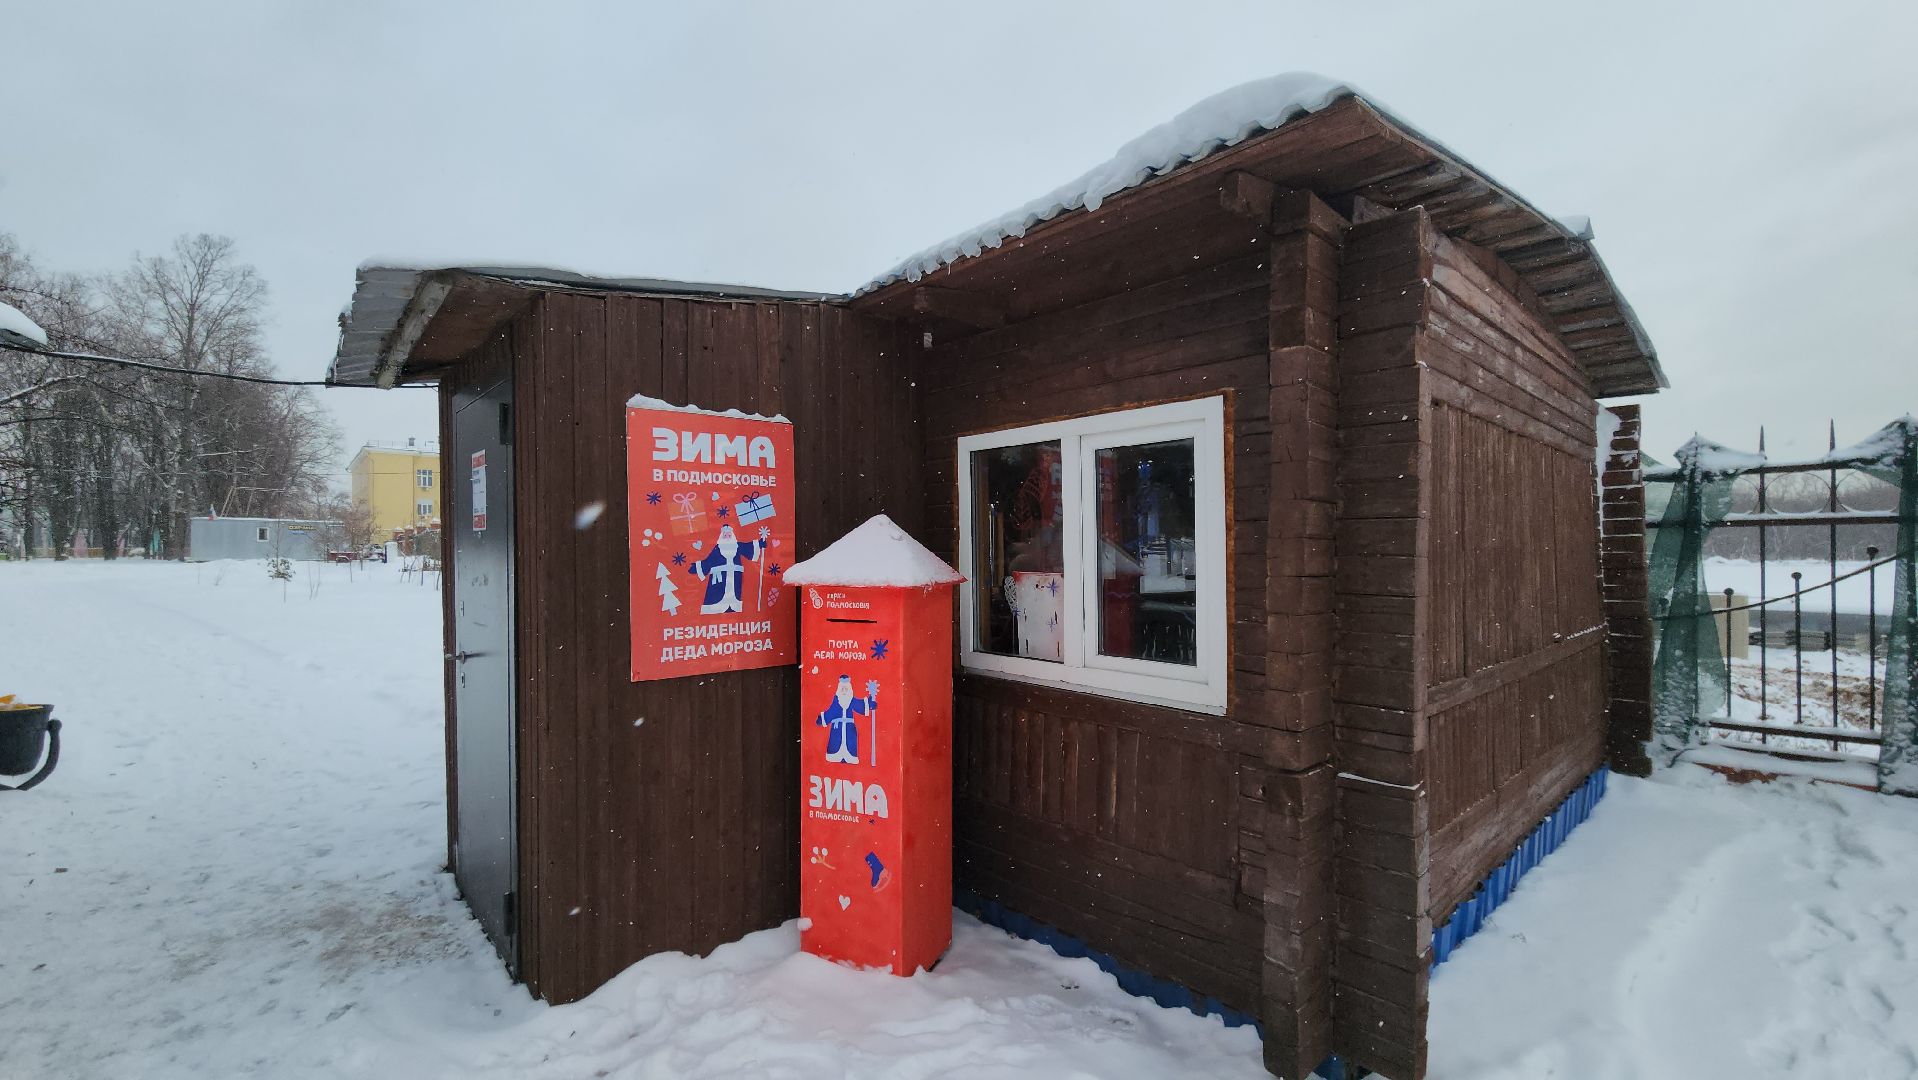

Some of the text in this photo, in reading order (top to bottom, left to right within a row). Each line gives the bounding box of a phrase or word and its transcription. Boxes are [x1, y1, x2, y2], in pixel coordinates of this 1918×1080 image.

[652, 427, 776, 469] ЗИМА
[653, 469, 777, 487] В ПОДМОСКОВЬЕ
[663, 620, 771, 641] РЕЗИДЕНЦИЯ
[660, 638, 774, 663] ДЕДА МОРОЗА
[828, 639, 859, 650] ПОЧТА
[813, 650, 867, 662] ДЕДА МОРОЗА
[809, 774, 889, 819] ЗИМА
[809, 810, 814, 818] В
